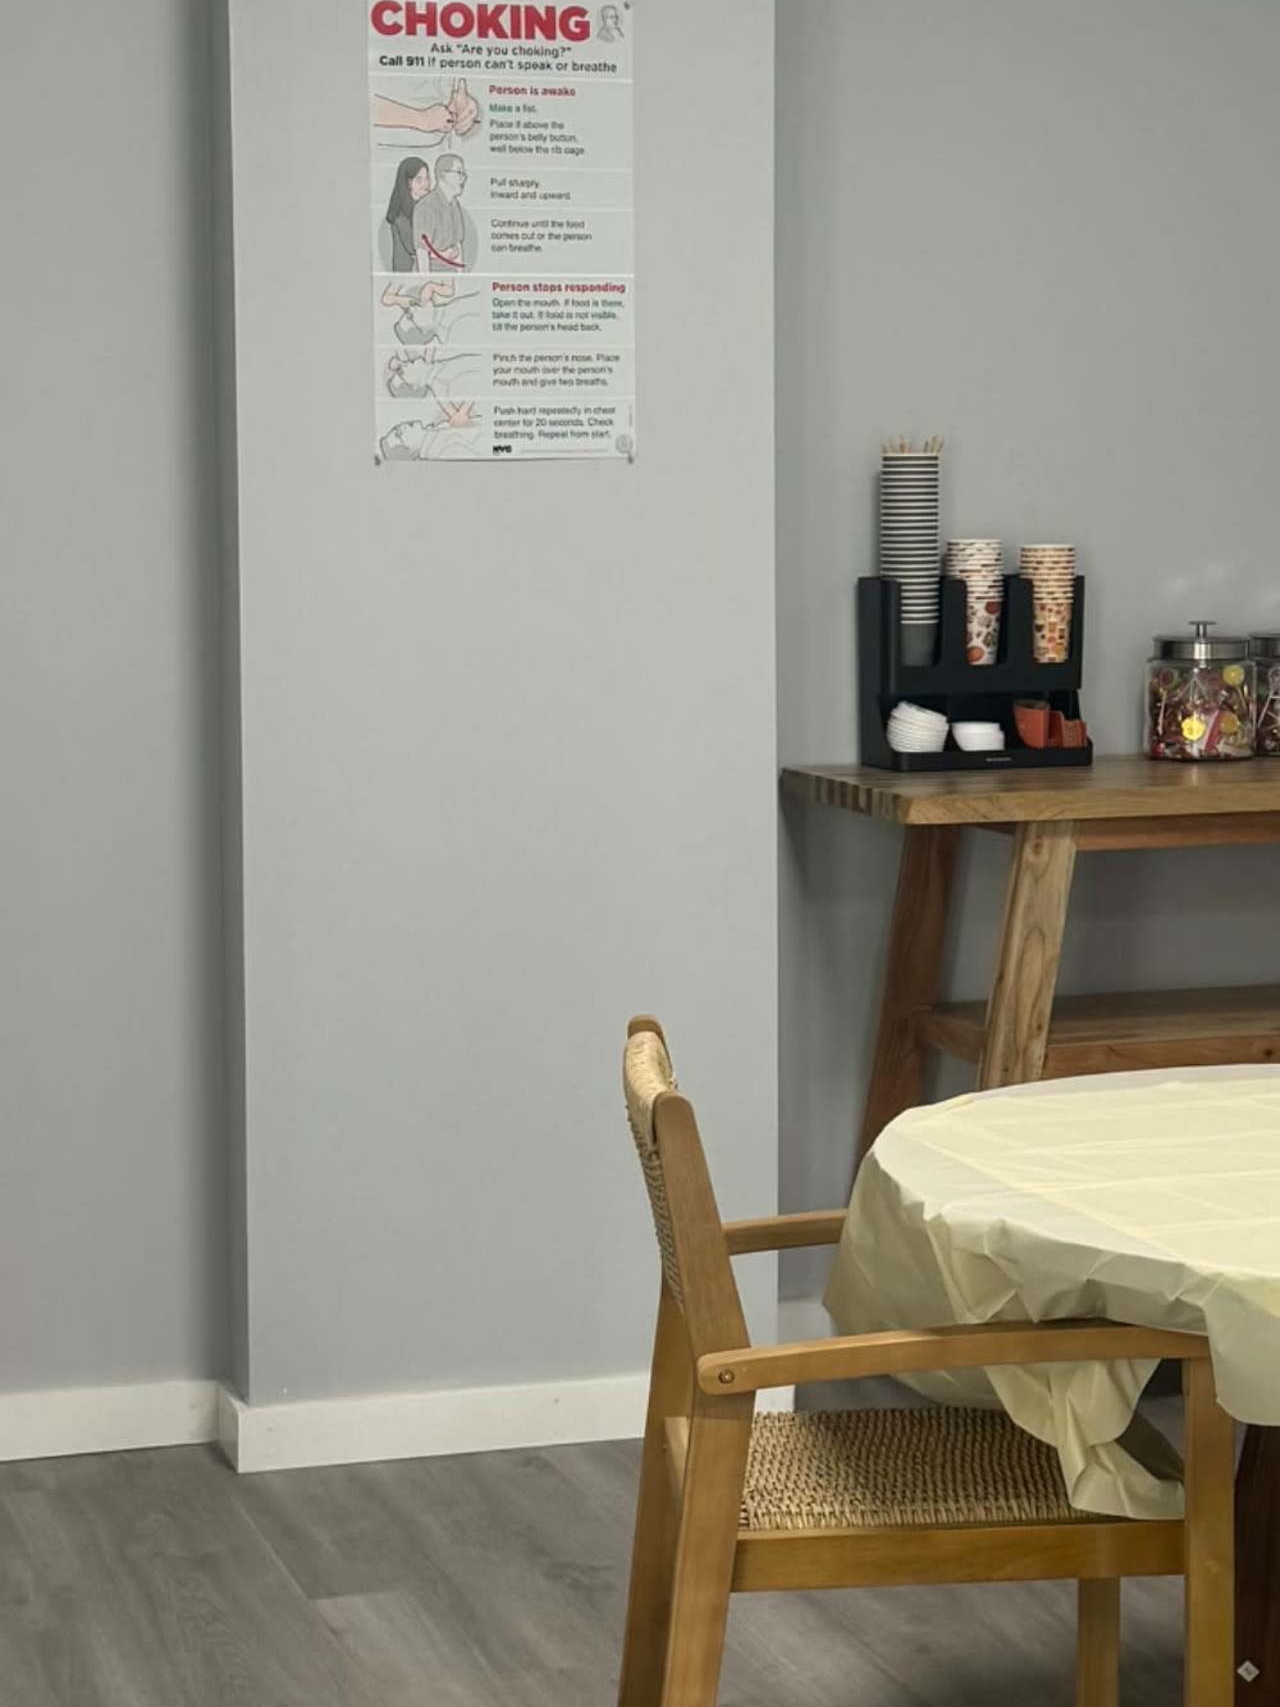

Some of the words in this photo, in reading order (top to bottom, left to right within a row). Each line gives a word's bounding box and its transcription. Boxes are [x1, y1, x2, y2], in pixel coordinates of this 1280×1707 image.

[370, 0, 591, 42] CHOKING
[430, 43, 453, 54] Ask
[487, 47, 508, 58] you
[379, 56, 403, 67] Call
[406, 57, 425, 68] 911
[428, 57, 436, 68] if
[440, 59, 481, 72] person
[485, 59, 514, 71] can't
[517, 61, 552, 73] speak
[556, 63, 568, 72] or
[572, 61, 617, 73] breathe
[489, 85, 528, 95] Person
[530, 86, 538, 95] is
[541, 87, 576, 97] awake
[489, 104, 513, 112] Make
[490, 119, 513, 128] Place
[551, 121, 564, 129] the
[521, 191, 537, 199] and
[492, 282, 530, 292] Person
[533, 283, 562, 293] stops
[565, 283, 625, 293] responding
[492, 298, 515, 307] Open
[518, 299, 531, 307] the
[571, 299, 590, 307] food
[546, 311, 563, 319] food
[557, 323, 578, 331] head
[519, 354, 532, 362] the
[514, 366, 540, 374] mouth
[562, 366, 574, 374] the
[536, 418, 547, 426] 20
[587, 418, 614, 426] Check
